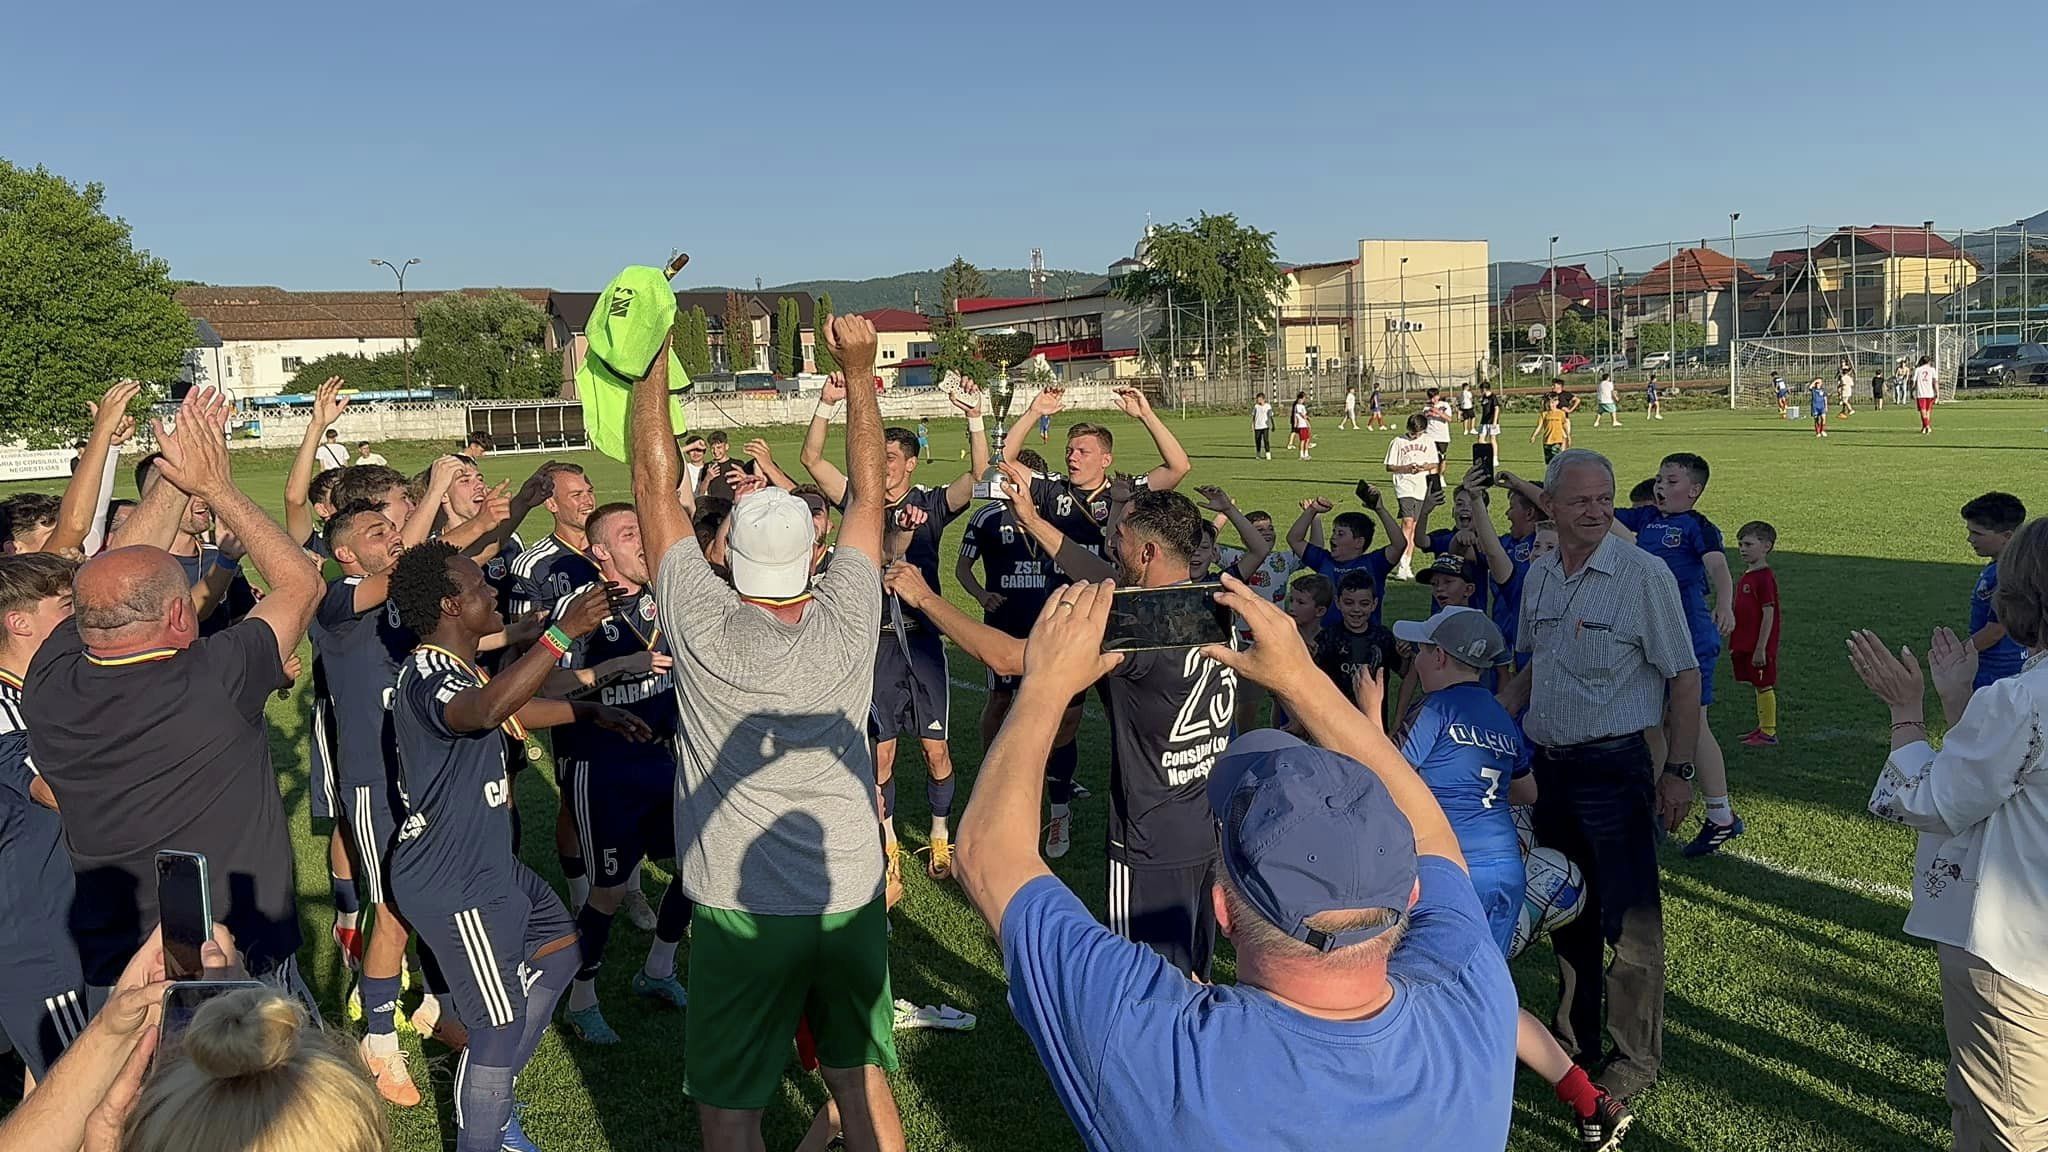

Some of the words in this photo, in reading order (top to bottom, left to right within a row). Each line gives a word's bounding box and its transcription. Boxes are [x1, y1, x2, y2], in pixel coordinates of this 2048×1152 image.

[1056, 494, 1073, 517] 13
[999, 525, 1015, 544] 18
[548, 572, 572, 598] 16
[1001, 575, 1046, 589] CARDIN
[602, 615, 620, 642] 5
[1481, 768, 1502, 809] 7
[603, 848, 619, 876] 5
